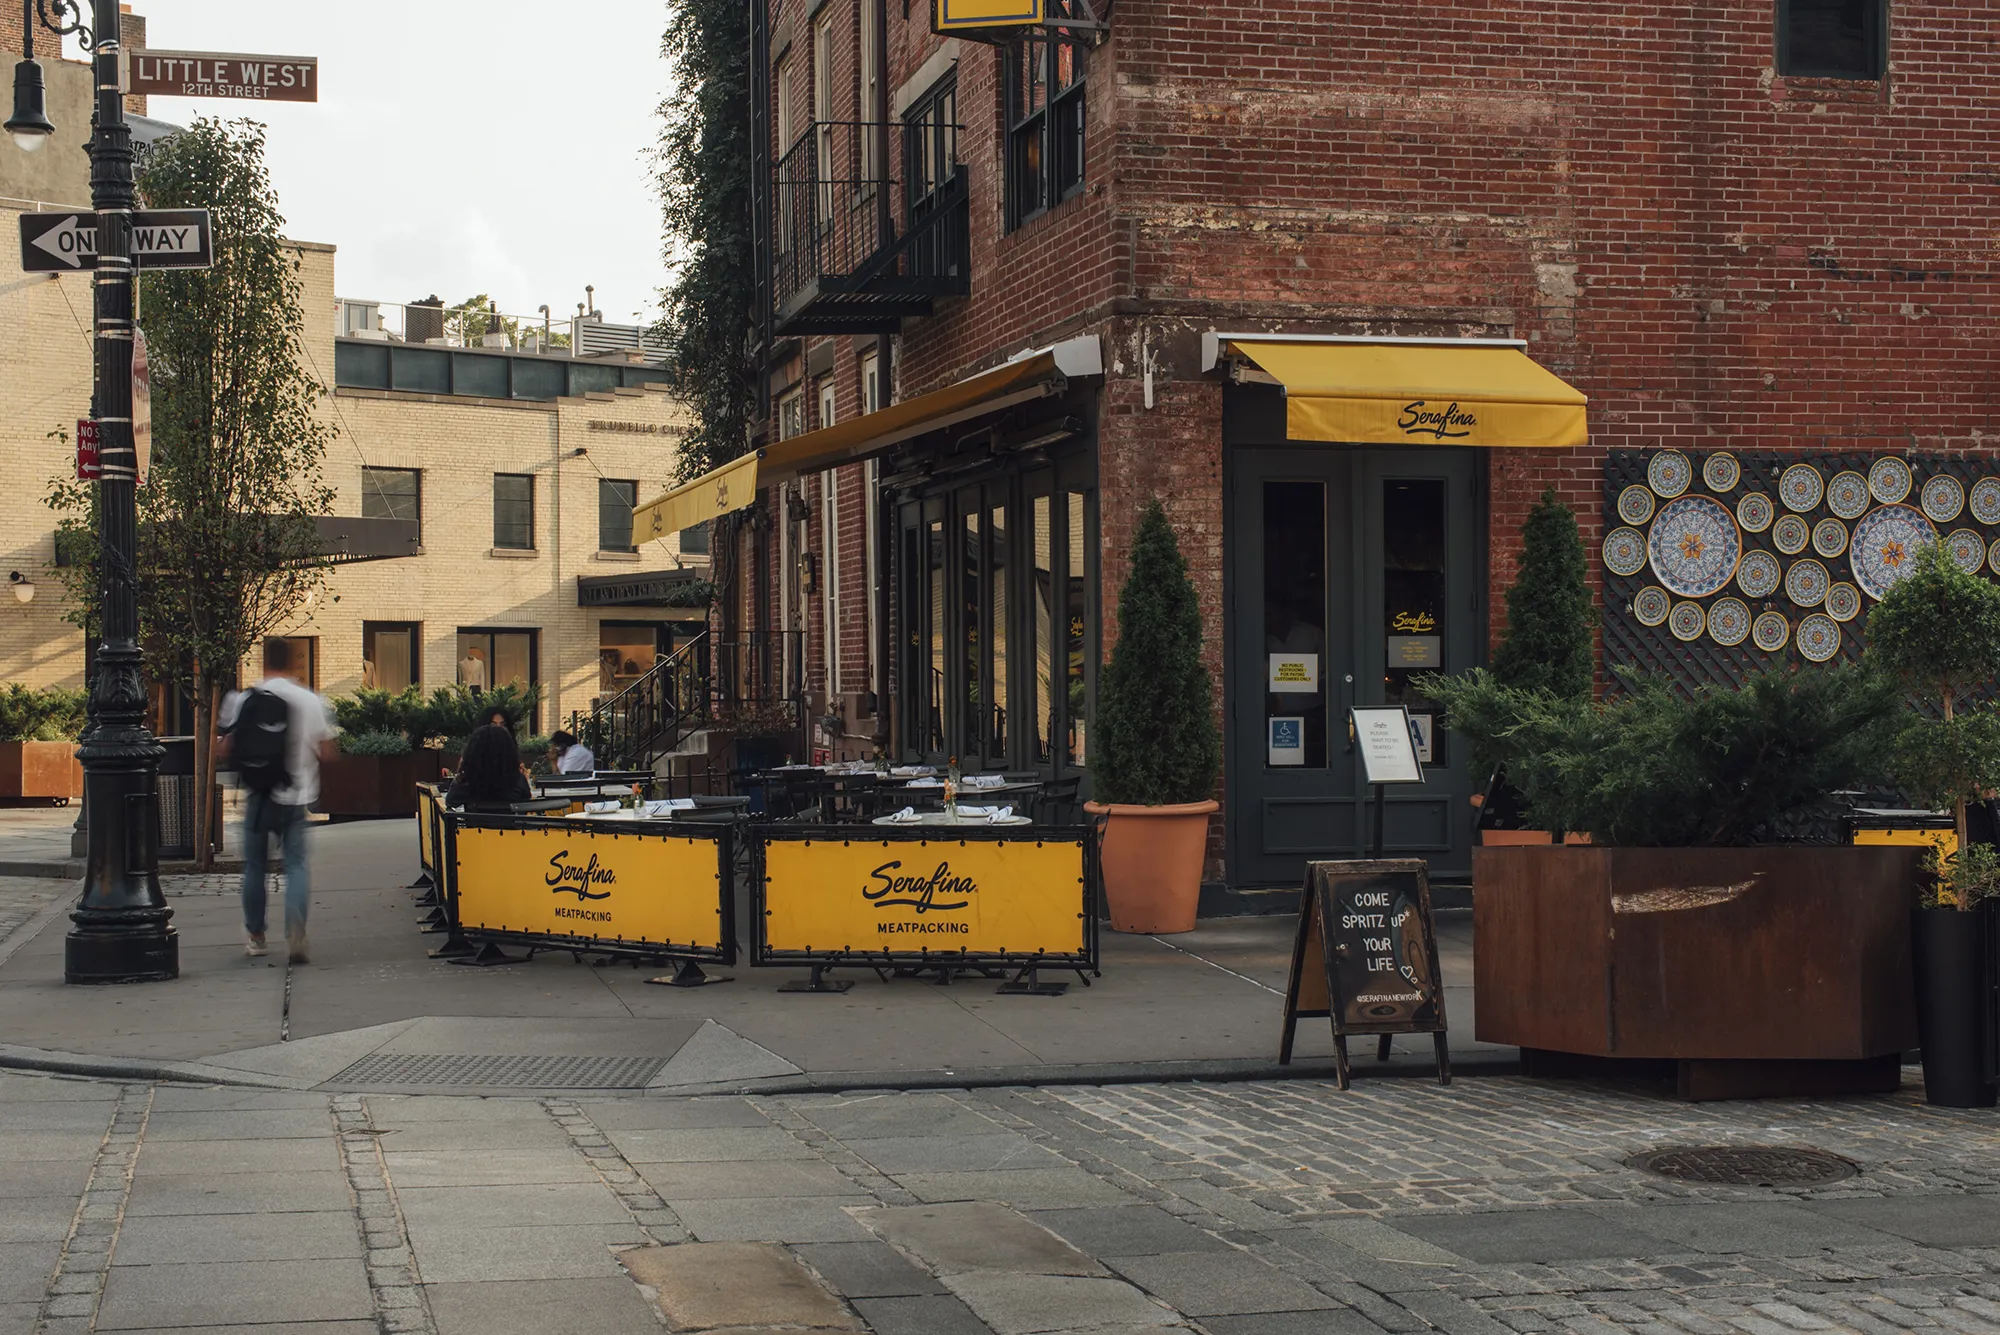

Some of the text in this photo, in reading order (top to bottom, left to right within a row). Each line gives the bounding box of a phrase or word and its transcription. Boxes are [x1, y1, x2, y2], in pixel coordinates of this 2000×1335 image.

[139, 57, 311, 88] LITTLE WEST
[181, 83, 270, 98] 12TH STREET
[58, 228, 189, 253] ON WAY
[590, 419, 658, 434] BRUNELLO
[1397, 400, 1477, 440] Serafina
[80, 425, 93, 438] NO
[1392, 611, 1436, 633] Serafina
[545, 849, 617, 902] Serafina
[862, 860, 979, 914] Serafina
[1354, 892, 1391, 907] COME
[554, 907, 612, 922] MEATPACKING
[1342, 914, 1386, 929] SPRITZ
[877, 922, 969, 934] MEATPACKING
[1366, 957, 1395, 972] LIFE
